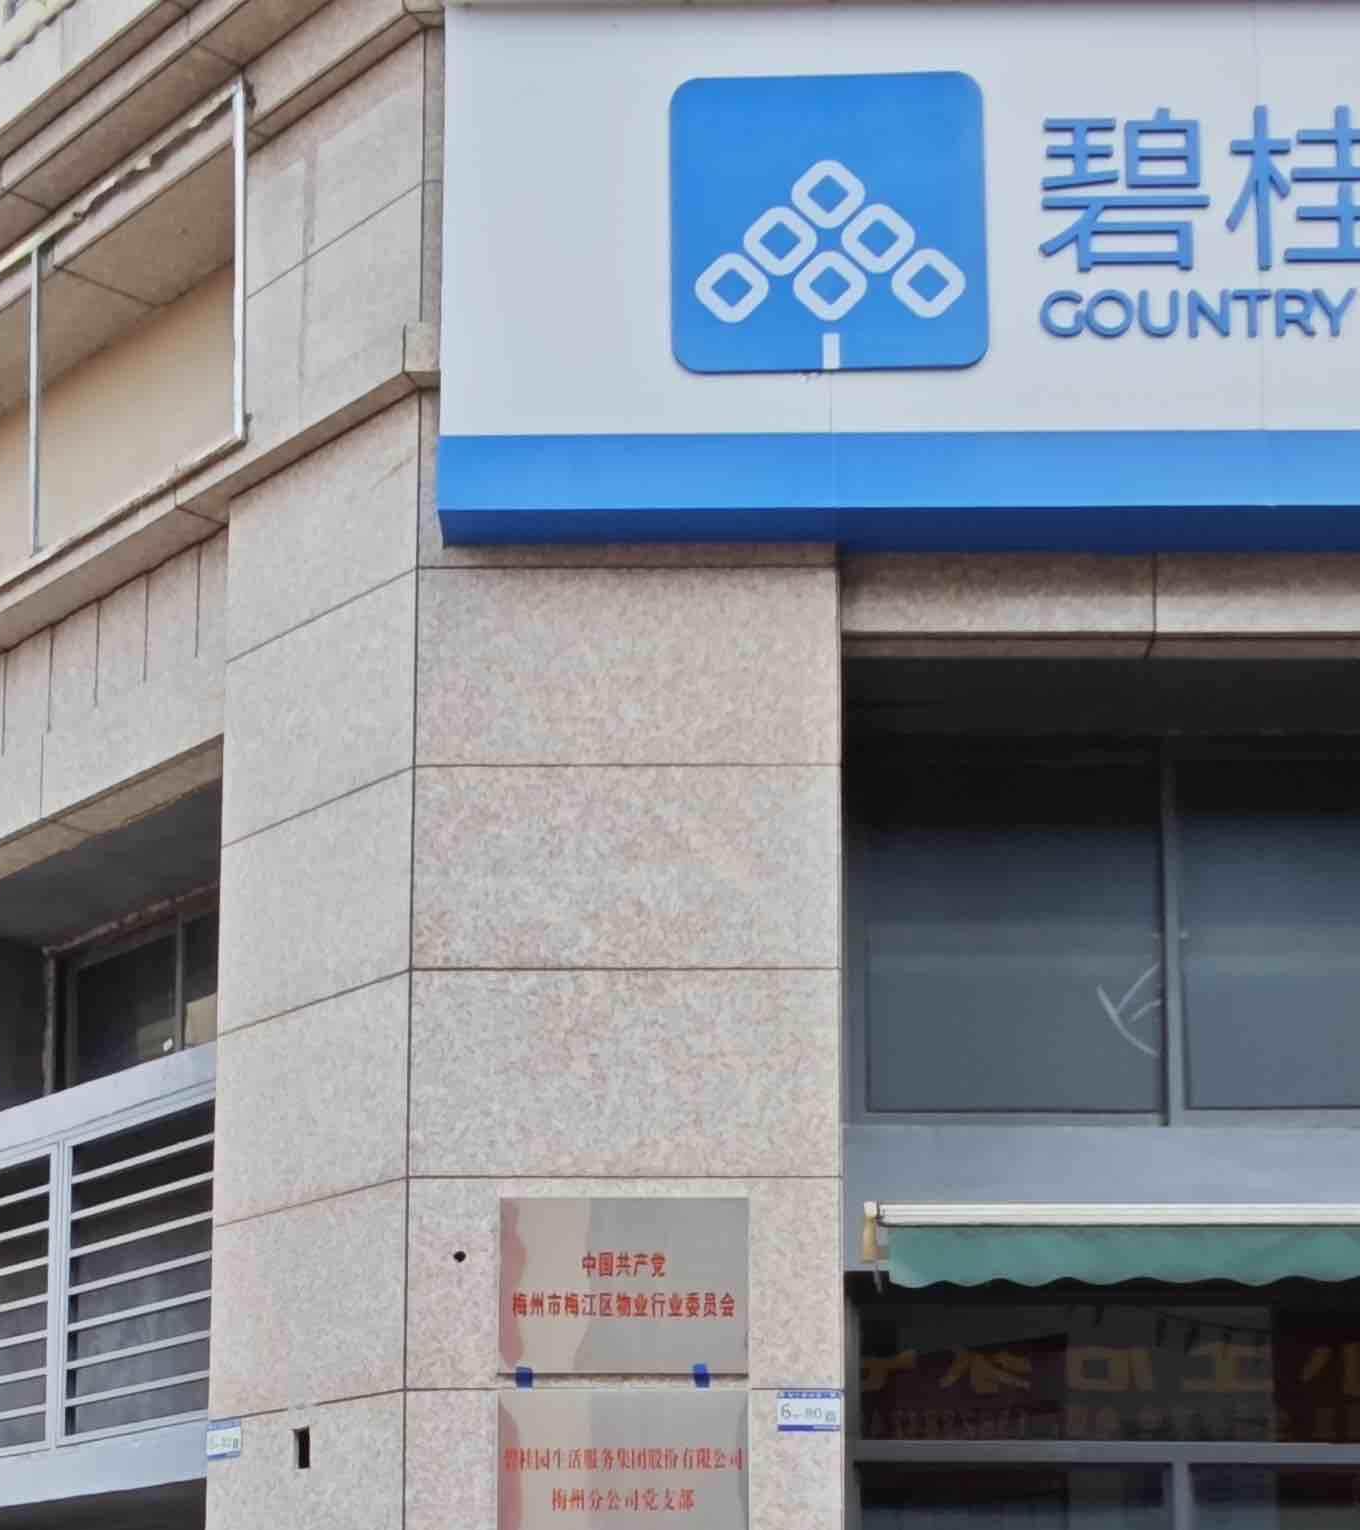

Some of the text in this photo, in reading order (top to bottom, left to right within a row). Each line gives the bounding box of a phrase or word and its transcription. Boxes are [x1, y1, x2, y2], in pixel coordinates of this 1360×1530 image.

[581, 1252, 666, 1278] 中国共产党
